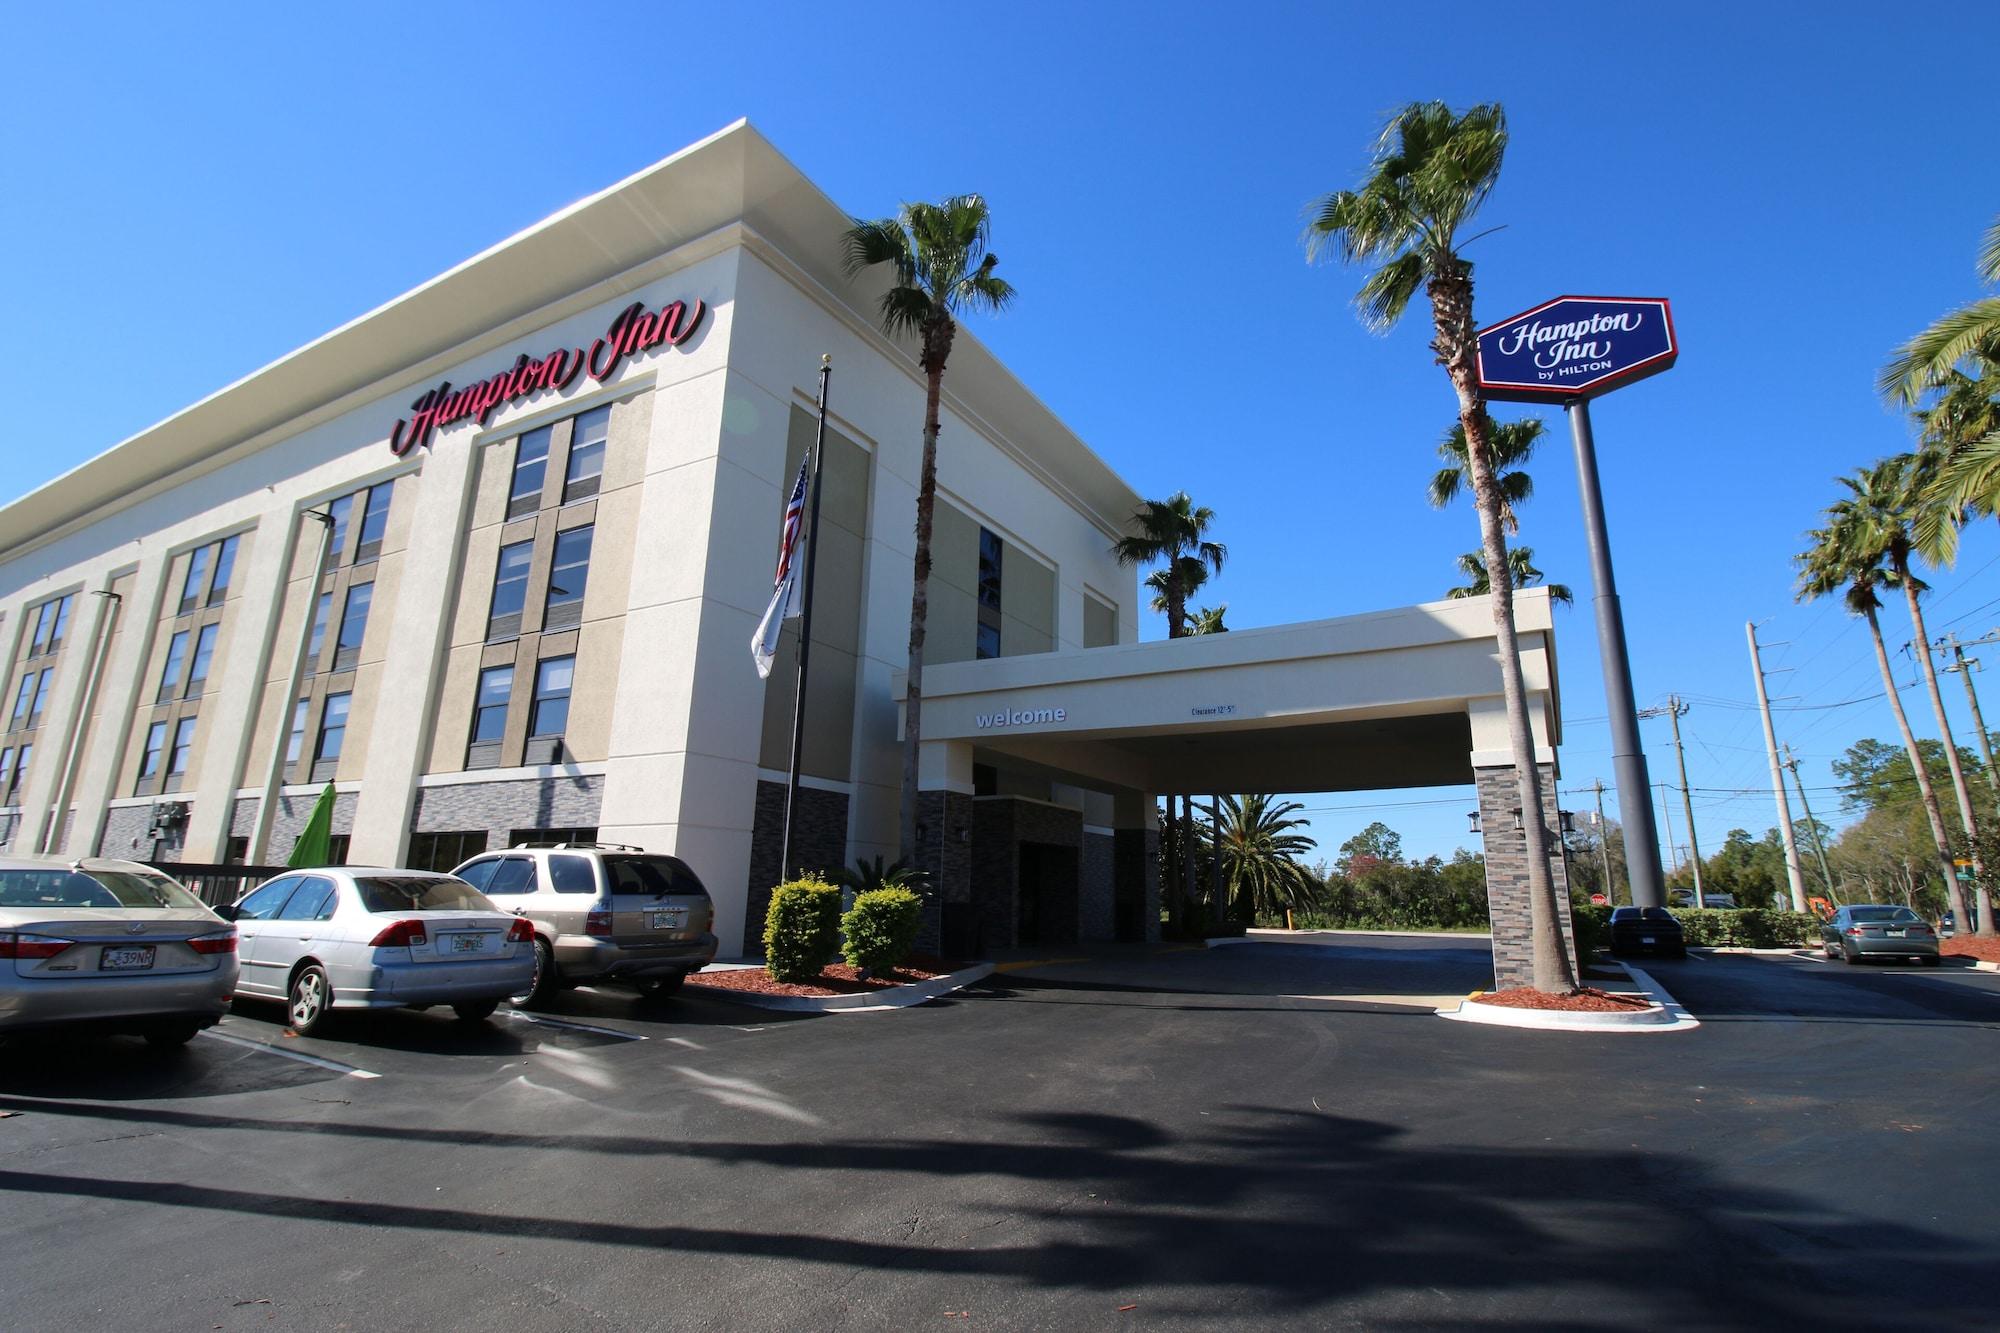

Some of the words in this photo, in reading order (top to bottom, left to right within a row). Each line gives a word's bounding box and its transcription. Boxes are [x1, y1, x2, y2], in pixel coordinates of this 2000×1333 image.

[1500, 312, 1642, 355] Hampton
[1534, 339, 1611, 369] Inn
[390, 348, 584, 456] Hampton
[586, 296, 706, 382] Inn
[1538, 371, 1554, 380] by
[1559, 360, 1612, 376] HILTON
[976, 707, 1066, 728] welcome
